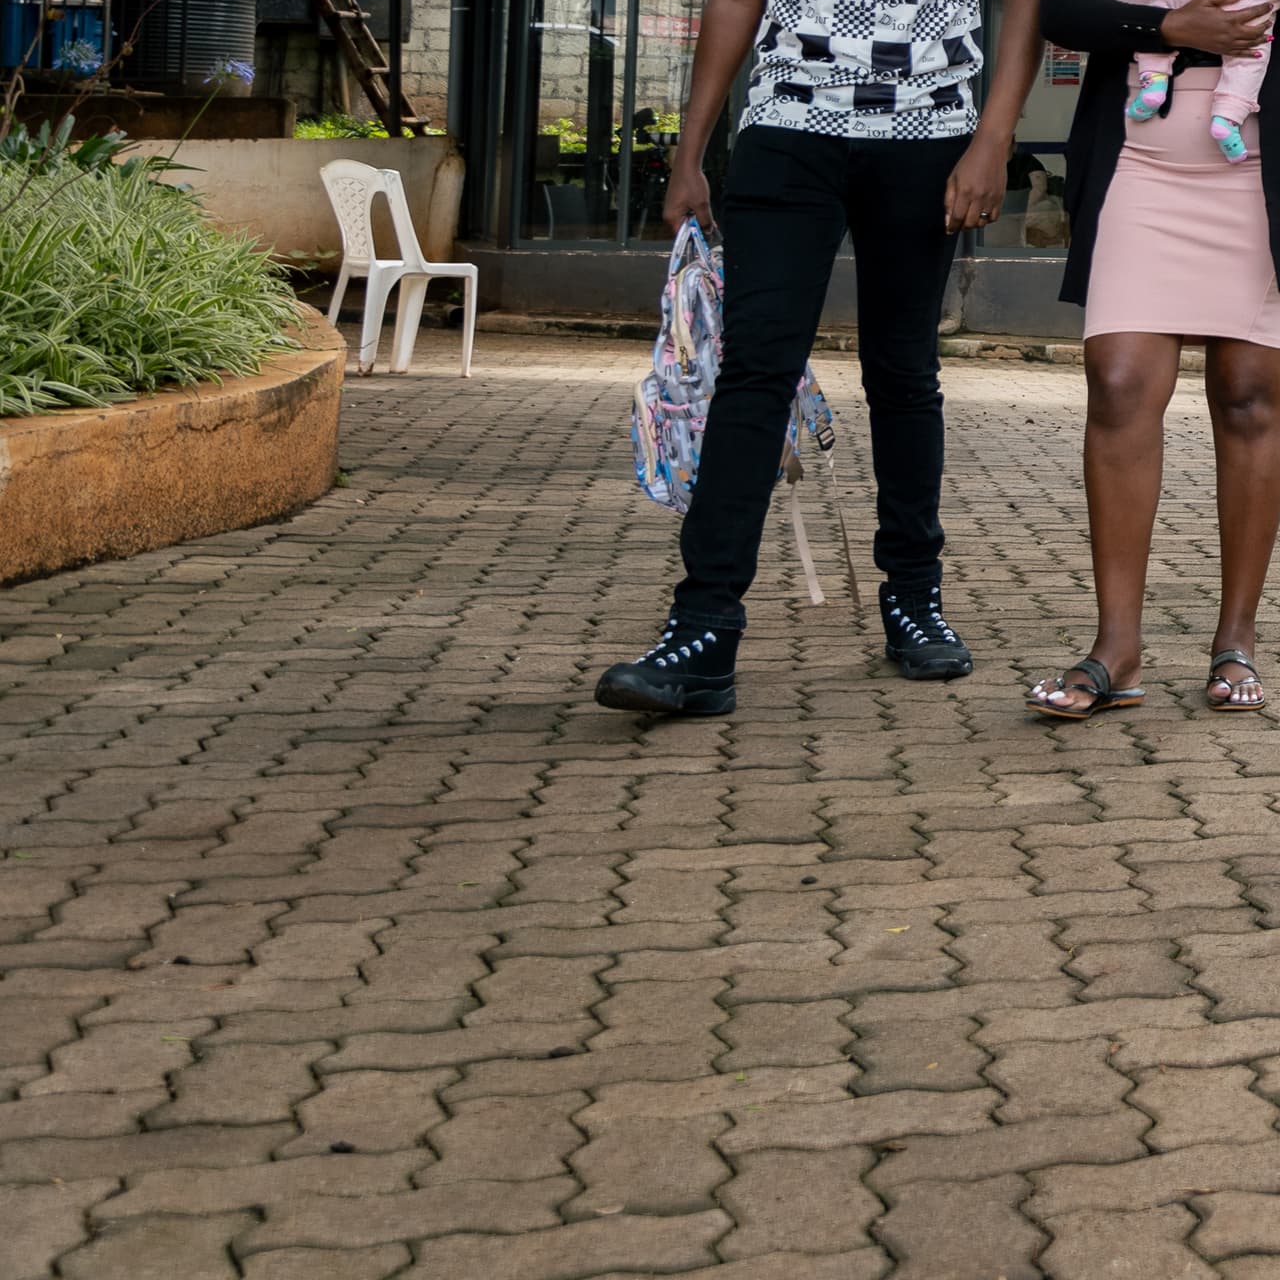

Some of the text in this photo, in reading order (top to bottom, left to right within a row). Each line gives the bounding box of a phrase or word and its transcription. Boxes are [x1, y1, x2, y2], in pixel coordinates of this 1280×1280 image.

[880, 14, 911, 31] Dior
[767, 109, 801, 128] Dior
[853, 121, 888, 137] Dior
